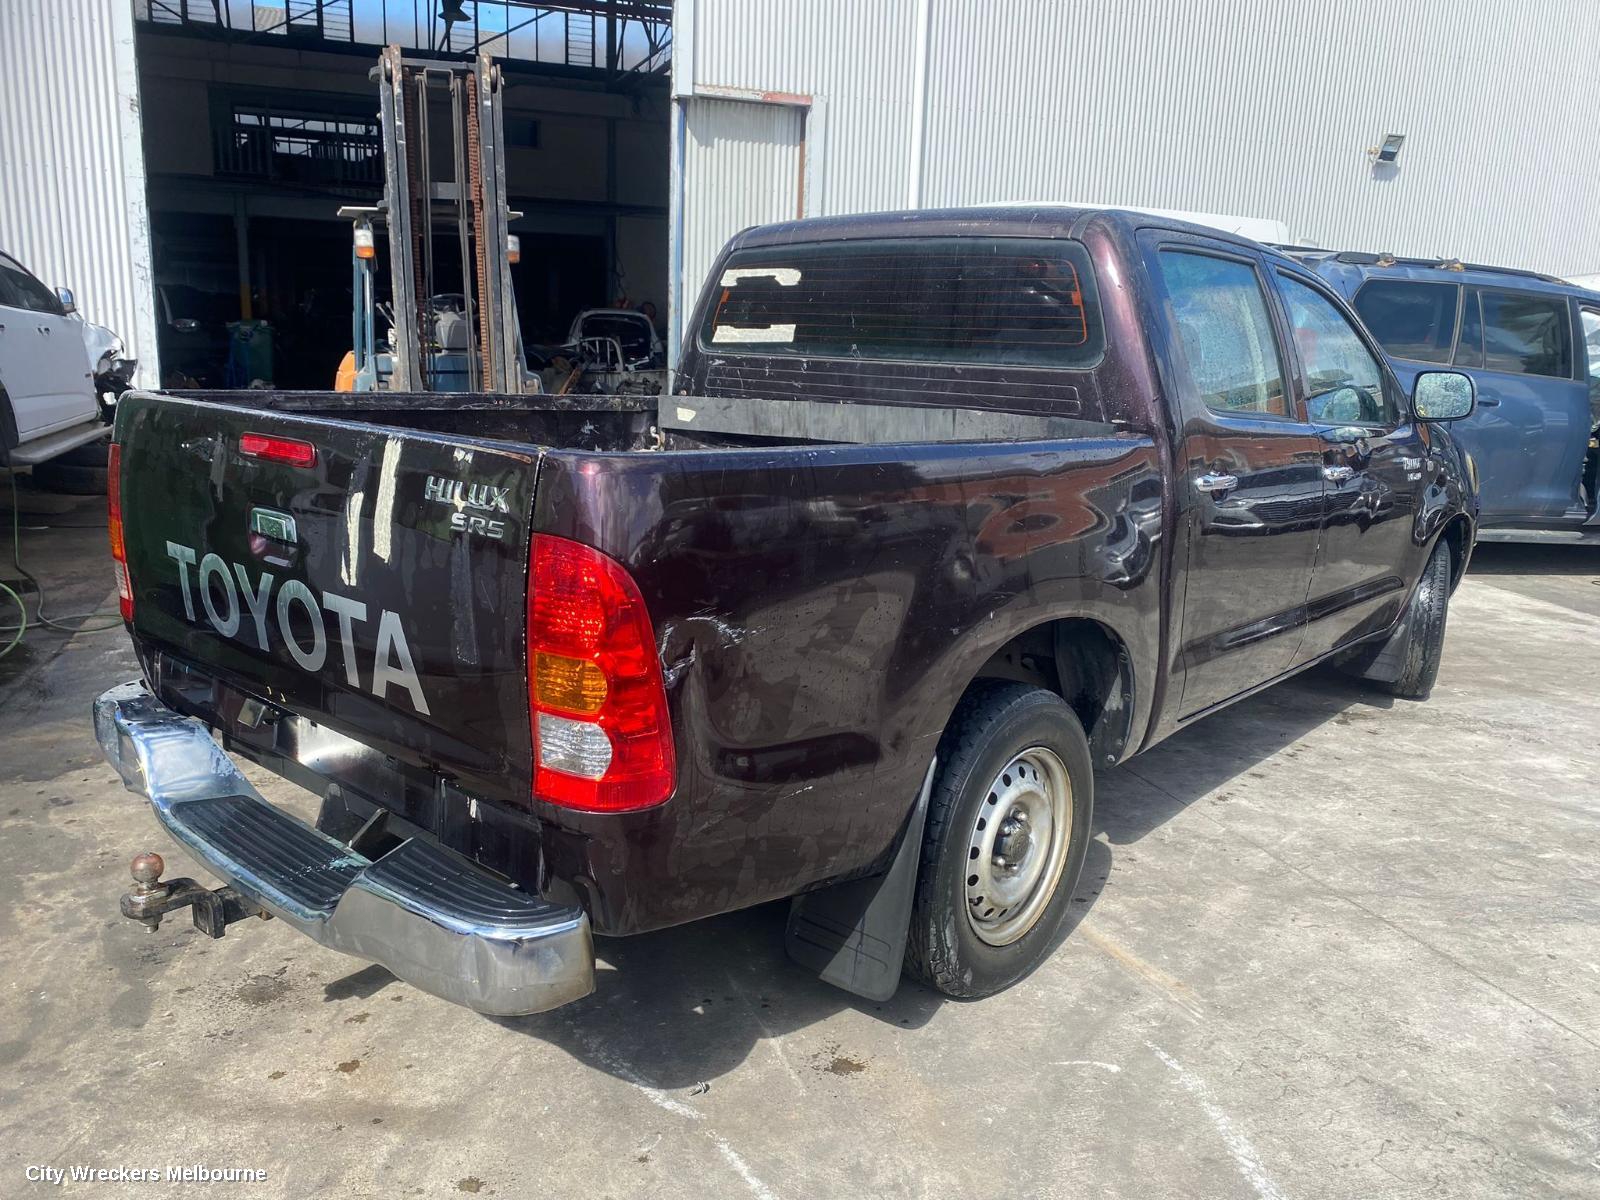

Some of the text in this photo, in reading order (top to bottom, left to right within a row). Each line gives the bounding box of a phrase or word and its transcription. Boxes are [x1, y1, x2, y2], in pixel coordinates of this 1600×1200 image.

[424, 475, 510, 514] HILUX
[450, 512, 505, 538] SR5
[166, 540, 431, 716] TOYOTA
